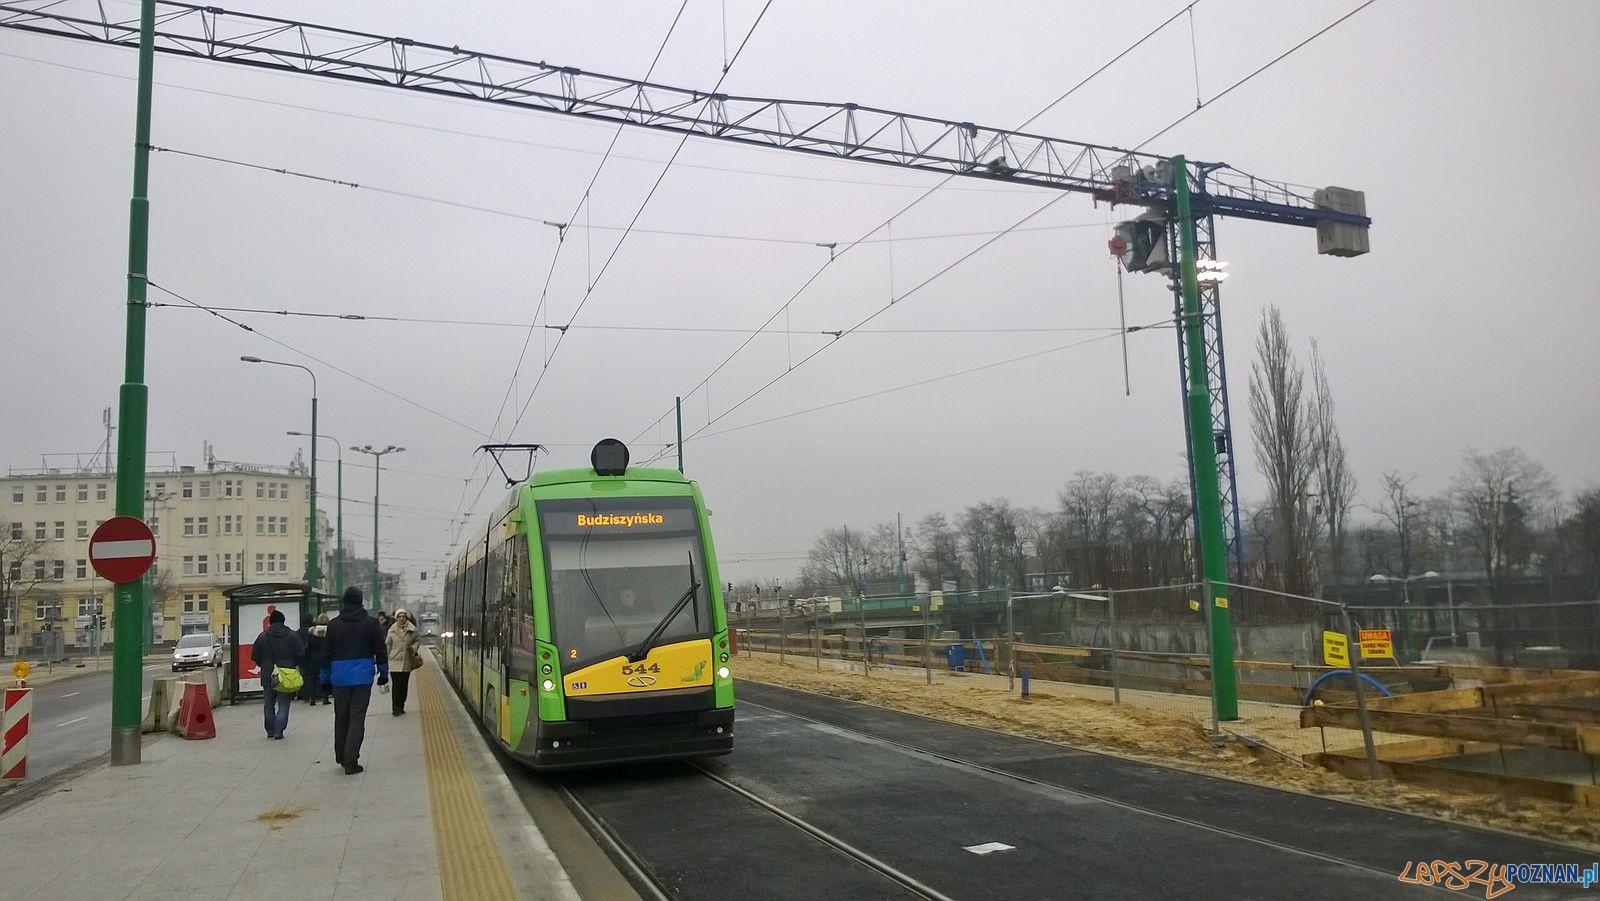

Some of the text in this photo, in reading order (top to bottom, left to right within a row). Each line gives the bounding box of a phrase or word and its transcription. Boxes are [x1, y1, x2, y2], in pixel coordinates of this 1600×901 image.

[577, 513, 663, 527] Budziszyńska
[1361, 632, 1389, 640] UWAGA
[570, 649, 577, 659] 2
[621, 662, 661, 676] 544
